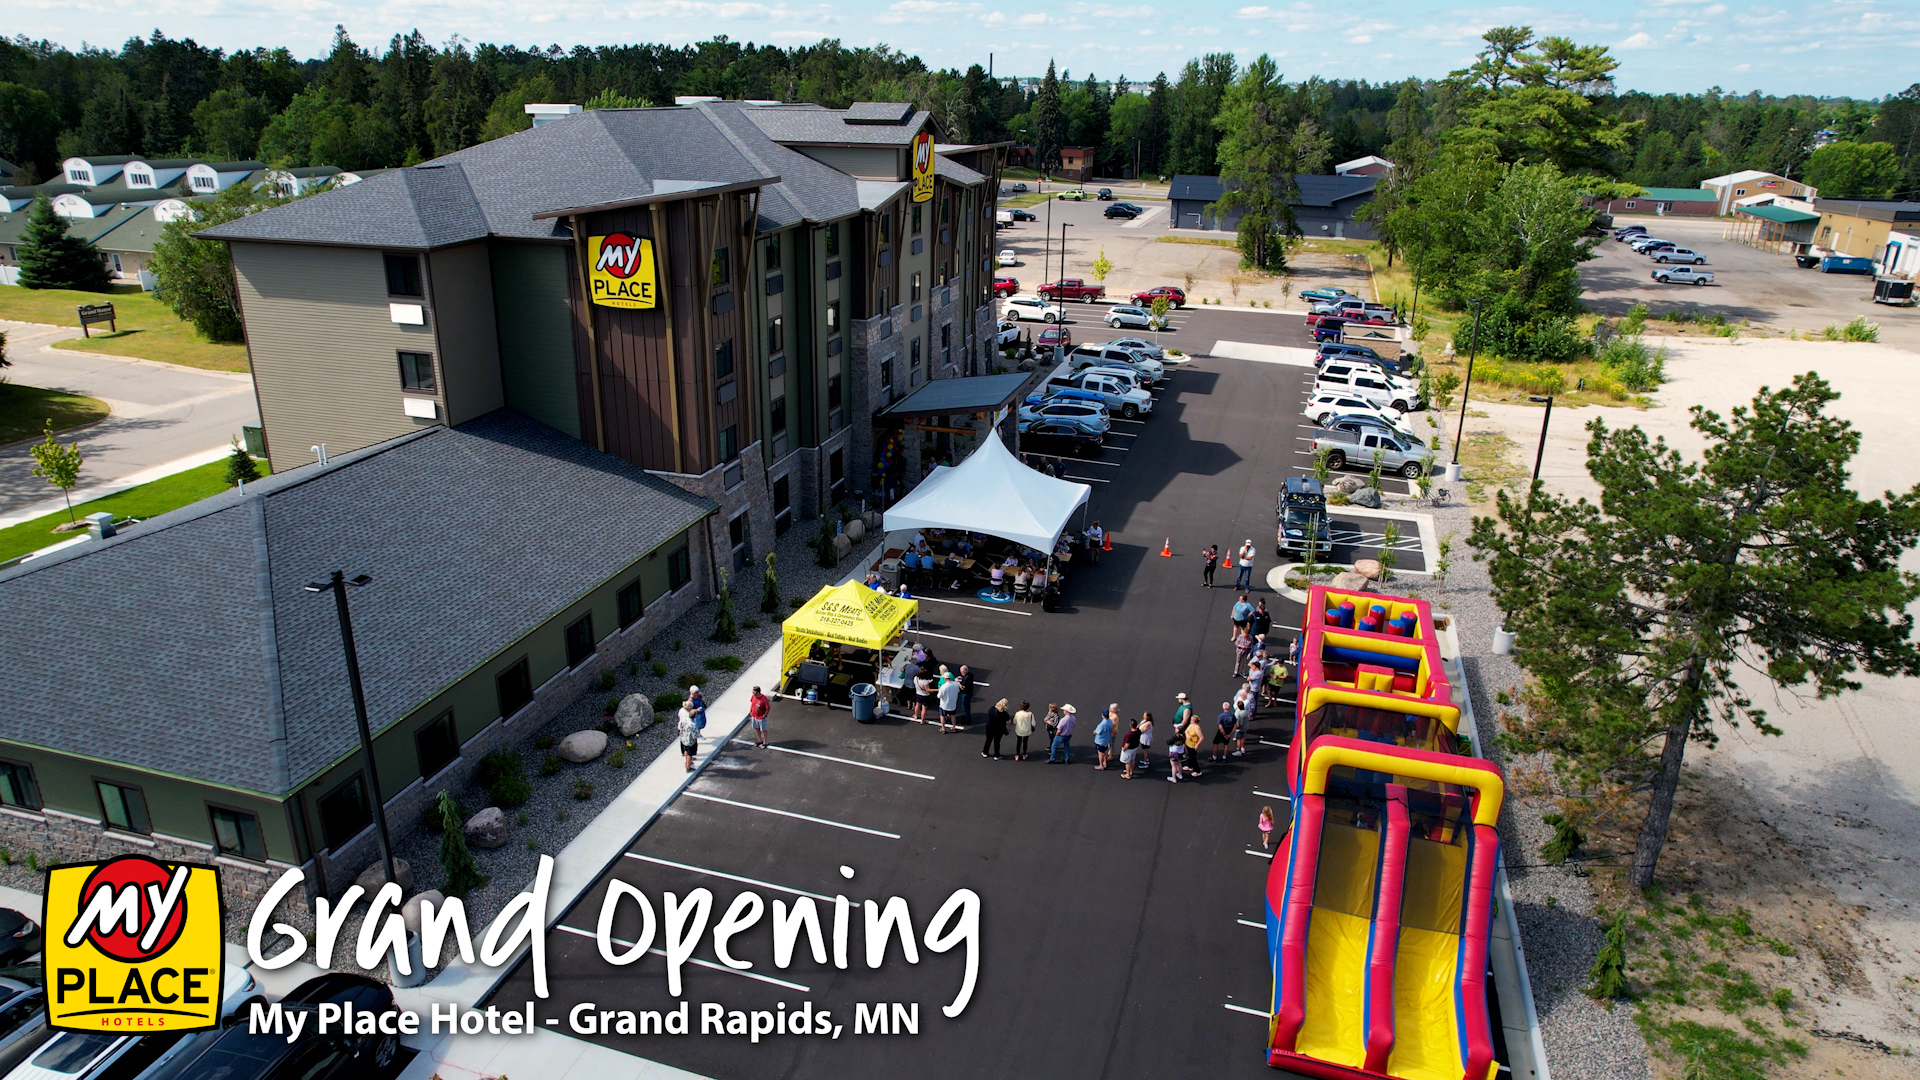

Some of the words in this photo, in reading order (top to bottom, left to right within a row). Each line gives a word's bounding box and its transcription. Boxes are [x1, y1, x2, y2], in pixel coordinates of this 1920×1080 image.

[913, 174, 933, 192] PLACE
[594, 279, 652, 298] PLACE
[821, 601, 840, 612] S&S
